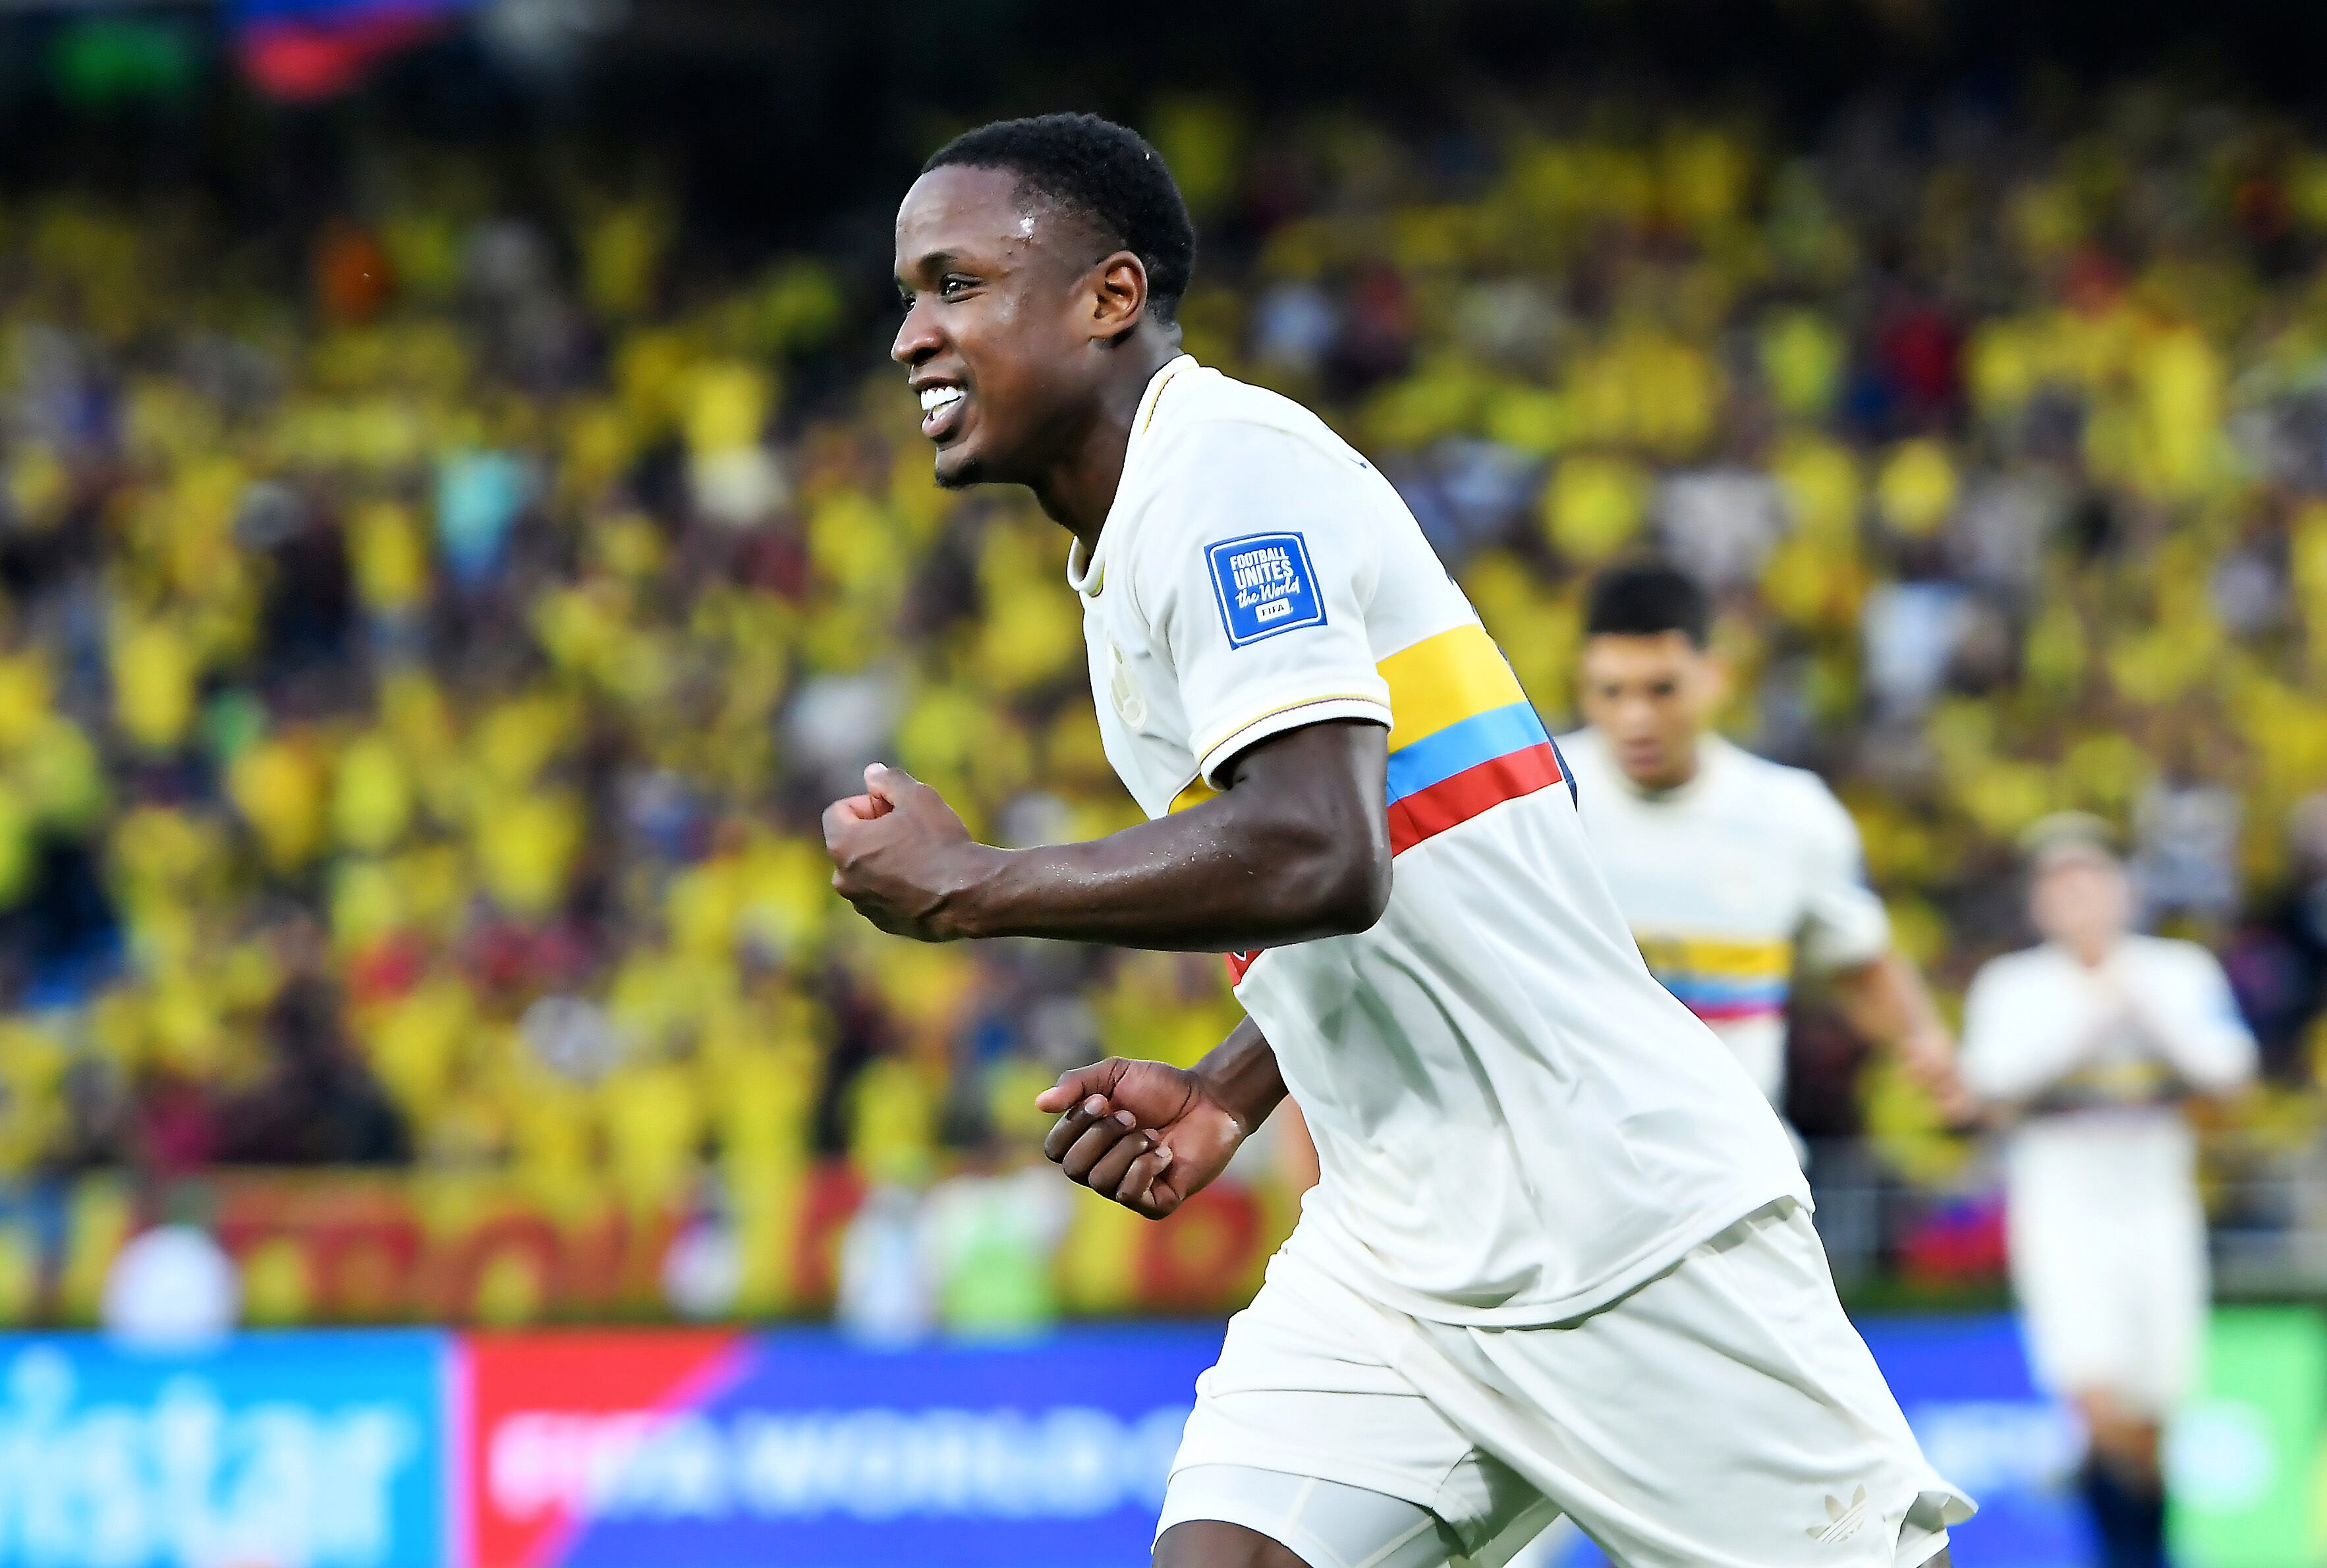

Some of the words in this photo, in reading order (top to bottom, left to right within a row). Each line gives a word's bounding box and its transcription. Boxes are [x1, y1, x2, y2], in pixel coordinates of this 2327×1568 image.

[1229, 547, 1289, 570] FOOTBALL
[1233, 559, 1293, 590] UNITES
[1235, 590, 1260, 609] the
[1259, 576, 1301, 602] World
[1262, 604, 1284, 616] FIFA
